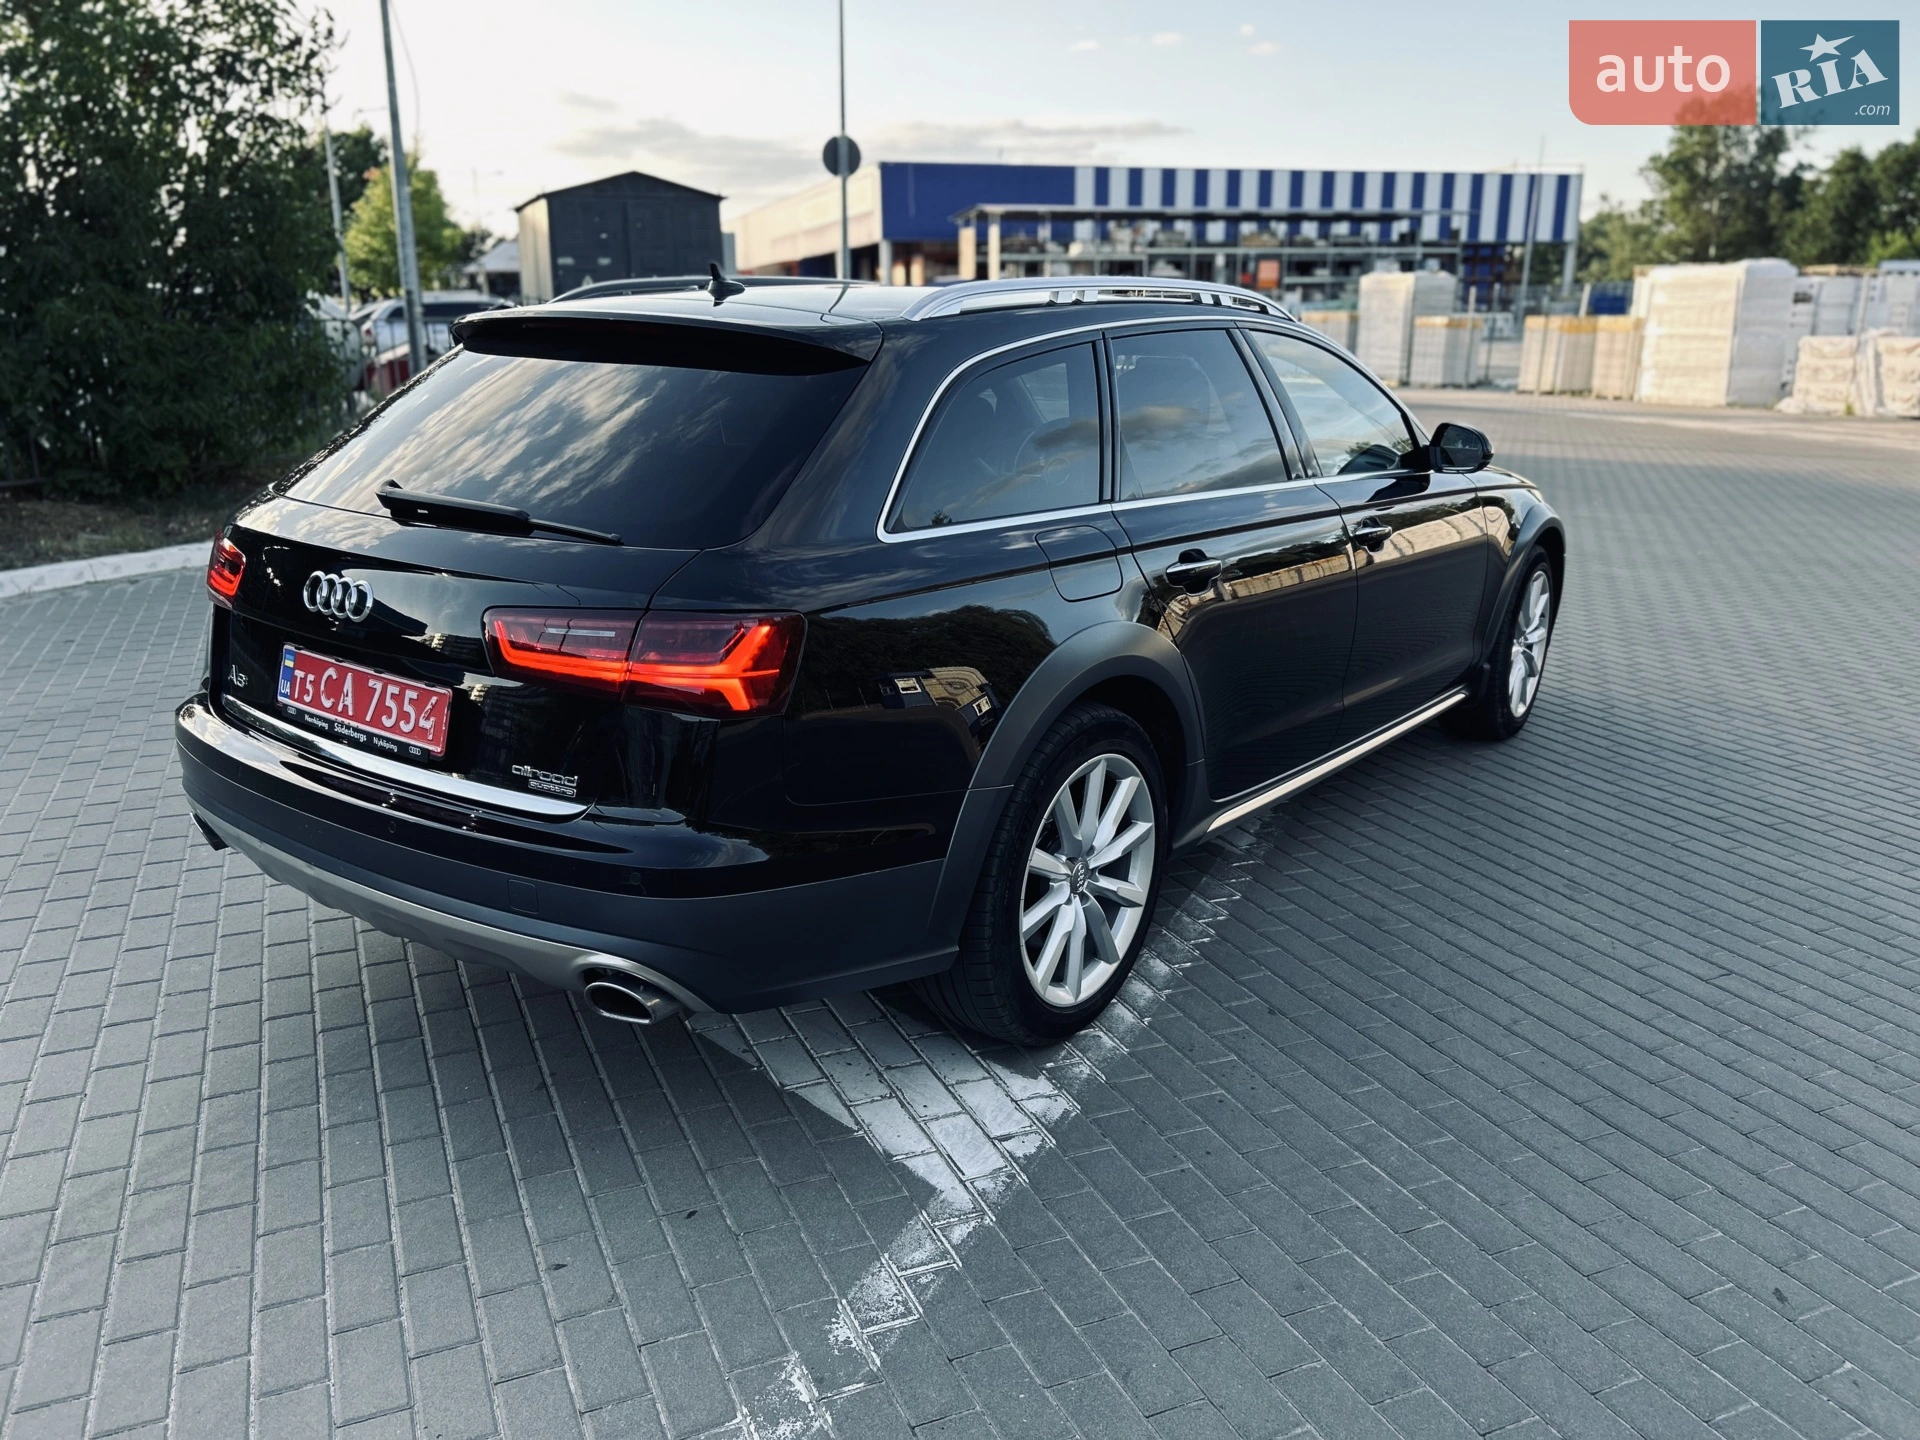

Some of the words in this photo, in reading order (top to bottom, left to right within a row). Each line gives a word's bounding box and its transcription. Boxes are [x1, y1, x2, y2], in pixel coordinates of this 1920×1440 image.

[280, 680, 291, 696] UA
[365, 678, 439, 741] 7554
[333, 722, 367, 742] Söderbergs
[373, 736, 398, 752] Nyköping
[511, 764, 579, 787] allroad
